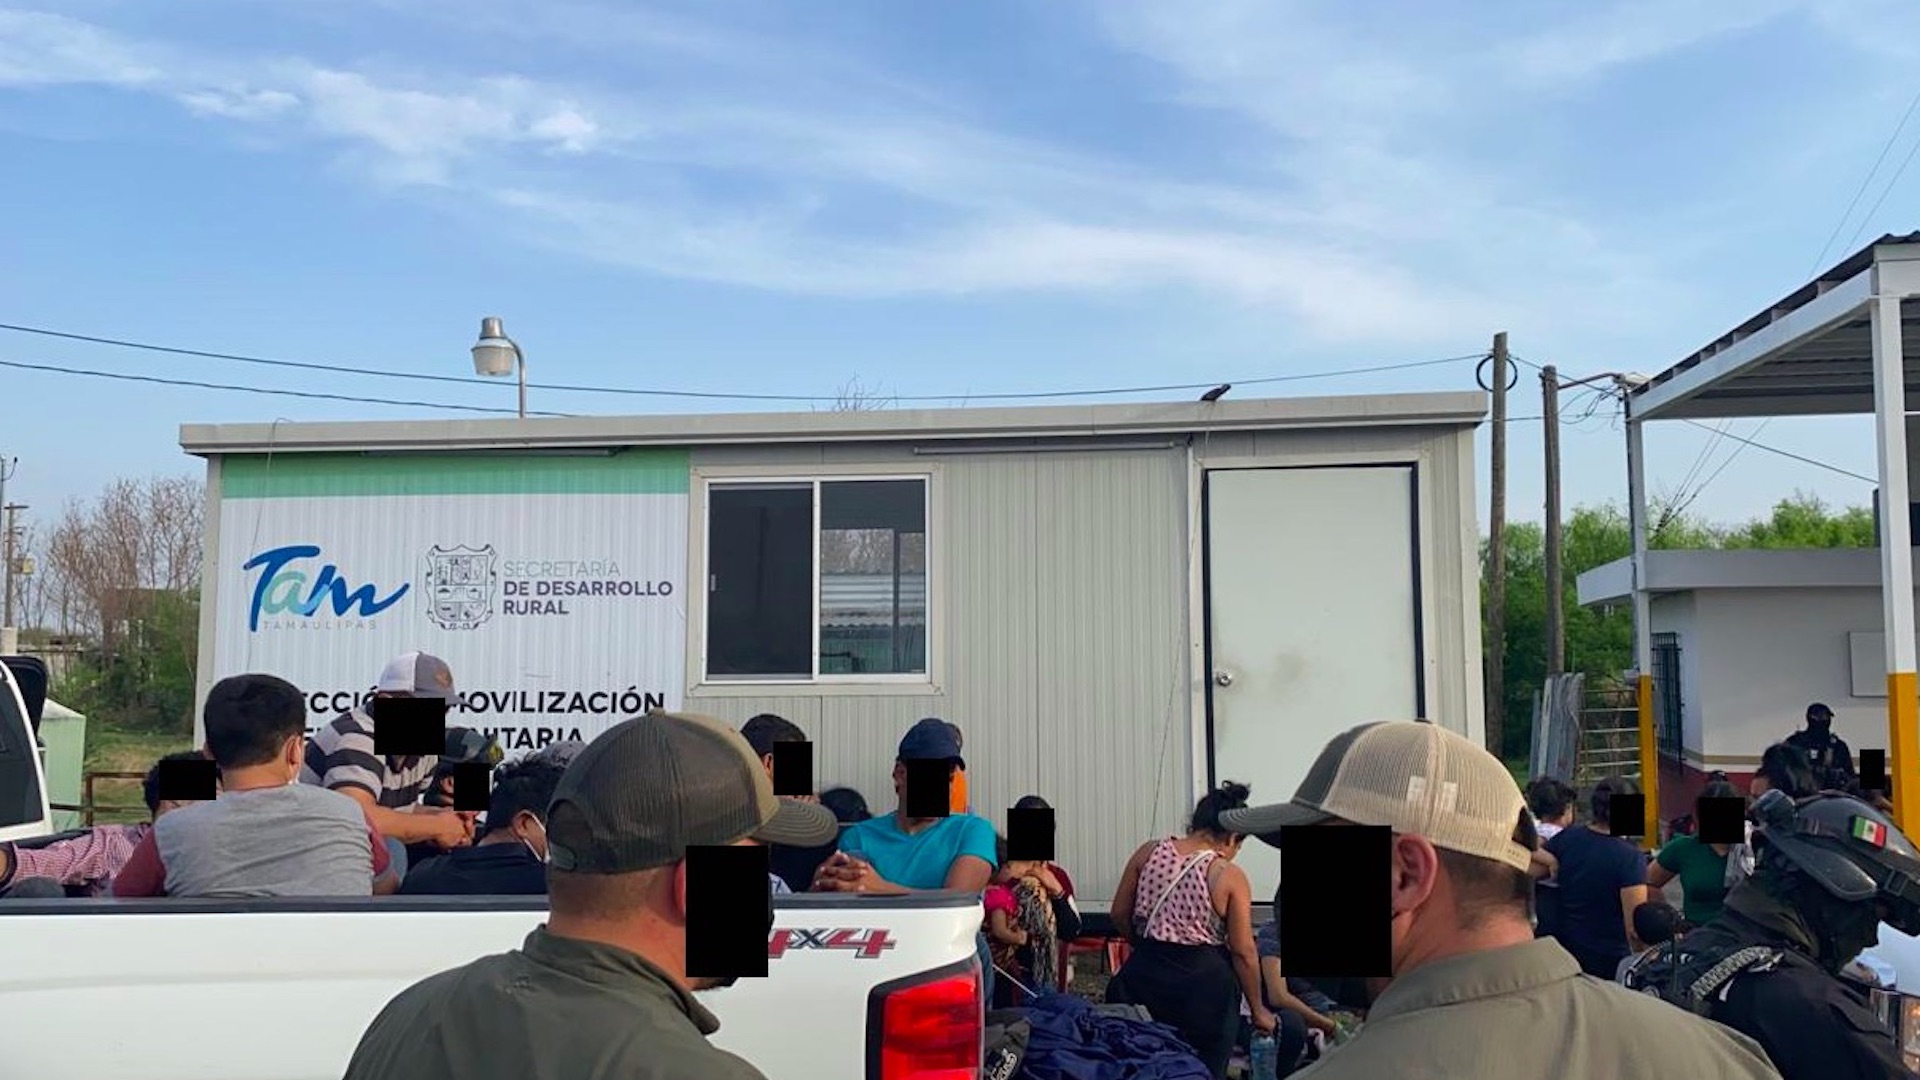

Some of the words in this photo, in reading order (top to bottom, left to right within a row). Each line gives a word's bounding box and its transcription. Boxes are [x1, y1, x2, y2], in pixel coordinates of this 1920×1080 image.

[503, 558, 621, 577] SECRETARÍA
[243, 545, 410, 632] Tam
[503, 581, 530, 596] DE
[536, 581, 673, 596] DESARROLLO
[503, 600, 570, 615] RURAL
[263, 620, 377, 630] TAMAULIPAS
